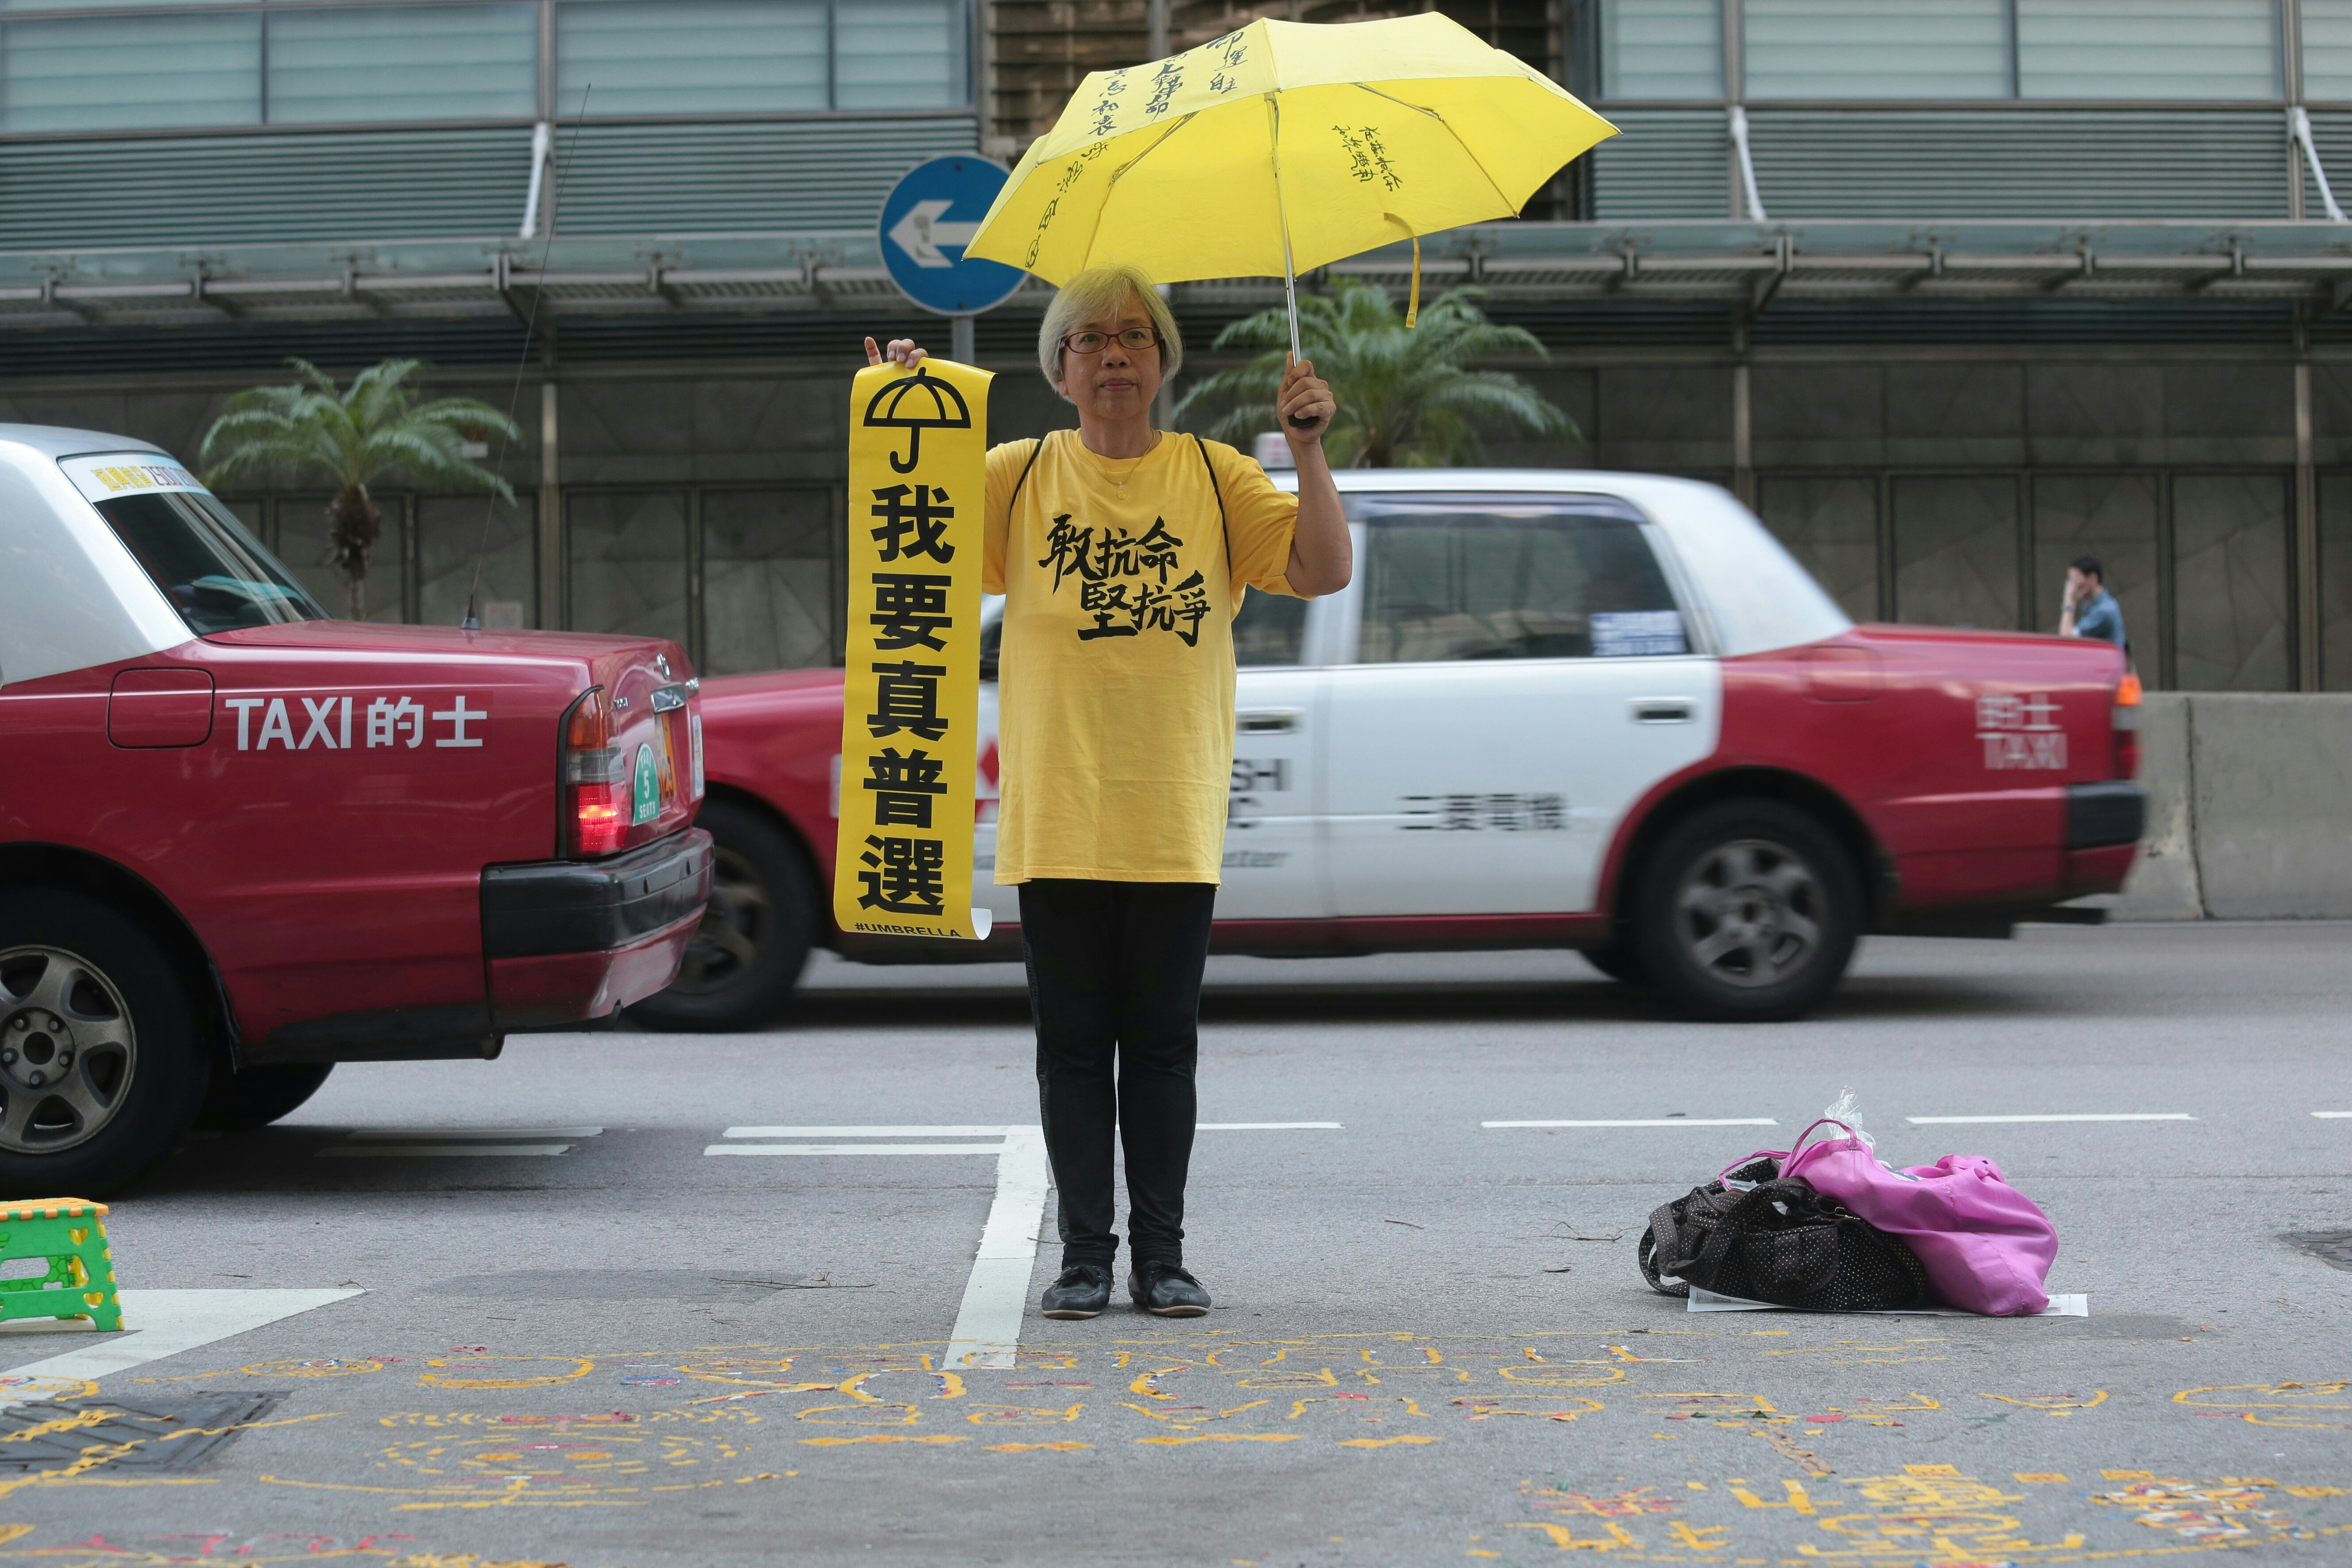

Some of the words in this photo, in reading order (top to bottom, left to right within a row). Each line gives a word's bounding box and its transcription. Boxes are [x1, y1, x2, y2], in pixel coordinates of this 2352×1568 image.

[1038, 513, 1184, 595] 敢抗命
[1077, 569, 1211, 647] 堅抗爭
[857, 483, 955, 917] 我要真普選
[1976, 693, 2063, 731] 的士
[225, 697, 353, 751] TAXI
[367, 696, 487, 748] 的士
[640, 750, 652, 768] TAXI
[1974, 732, 2068, 770] TAXI
[644, 771, 650, 799] 5
[639, 801, 656, 819] SEATS
[854, 922, 962, 937] #UMBRELLA
